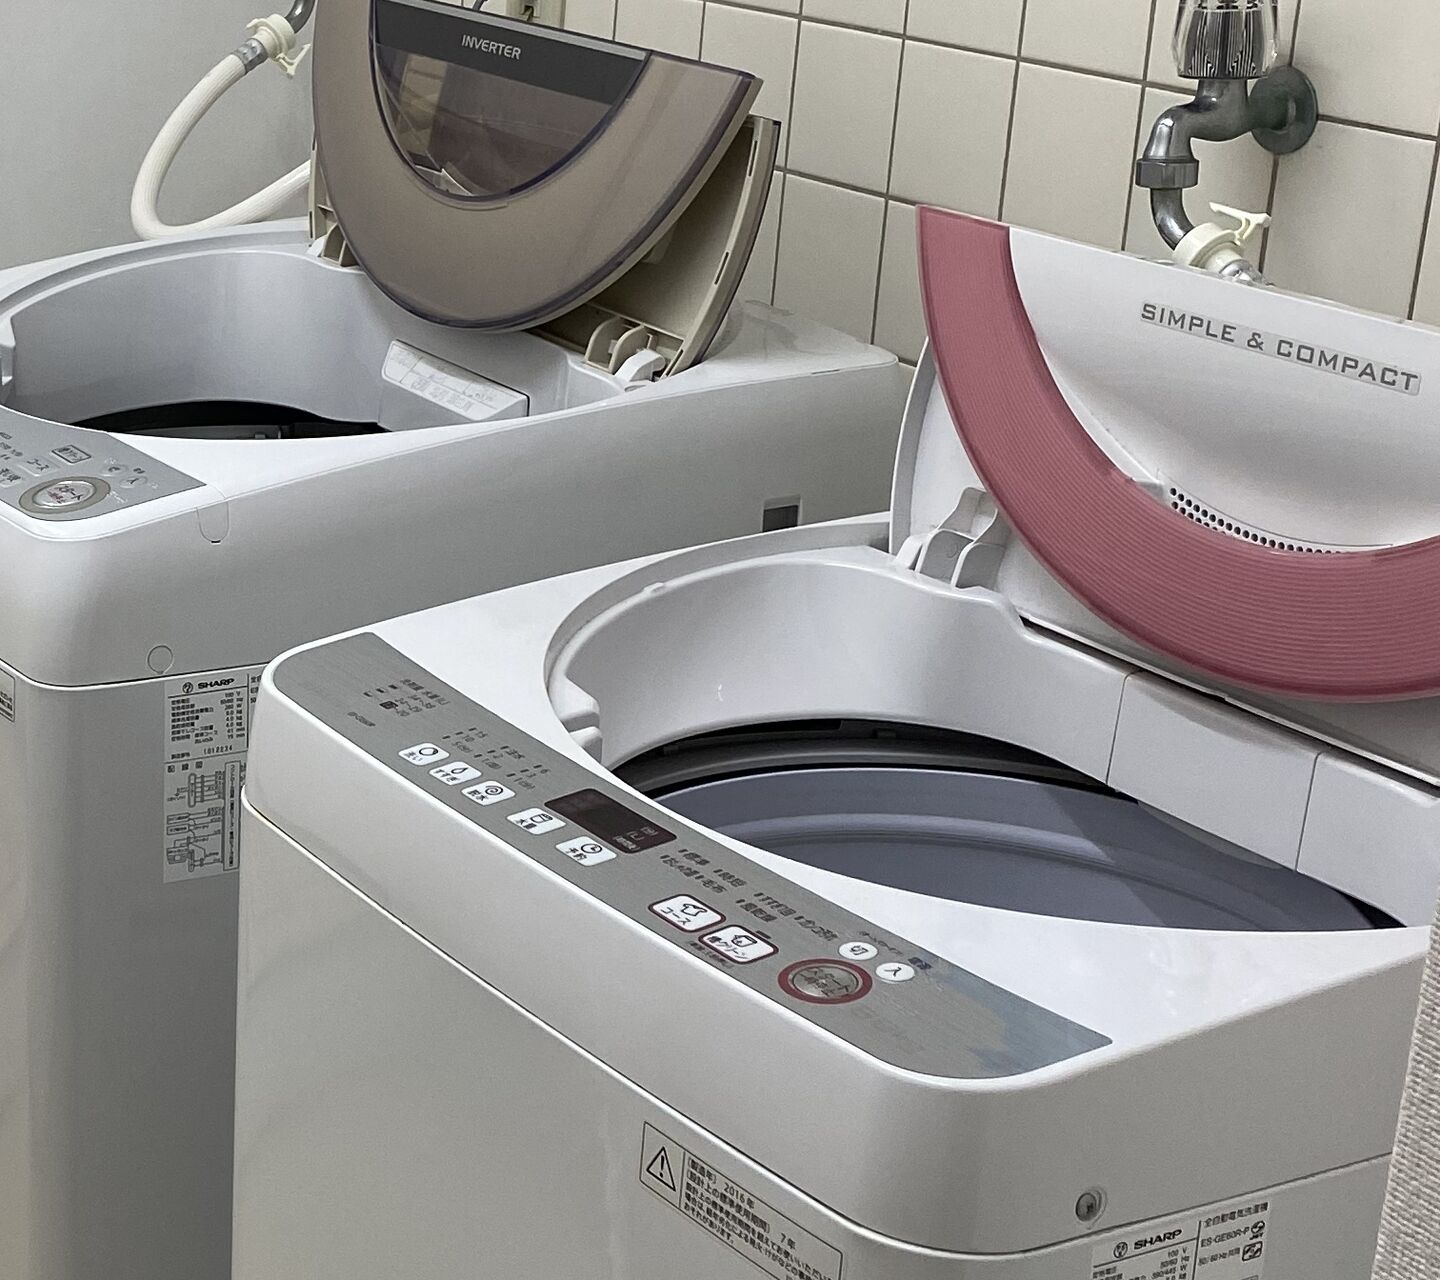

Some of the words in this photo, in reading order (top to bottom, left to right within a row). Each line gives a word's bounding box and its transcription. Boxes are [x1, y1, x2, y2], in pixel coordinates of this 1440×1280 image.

[461, 34, 522, 60] INVERTER
[1141, 303, 1237, 343] SIMPLE
[1246, 332, 1264, 351] &
[1276, 339, 1419, 391] COMPACT
[198, 677, 235, 690] SHARP
[702, 879, 727, 894] 毛布
[660, 906, 692, 926] コース
[1133, 1228, 1182, 1251] SHARP
